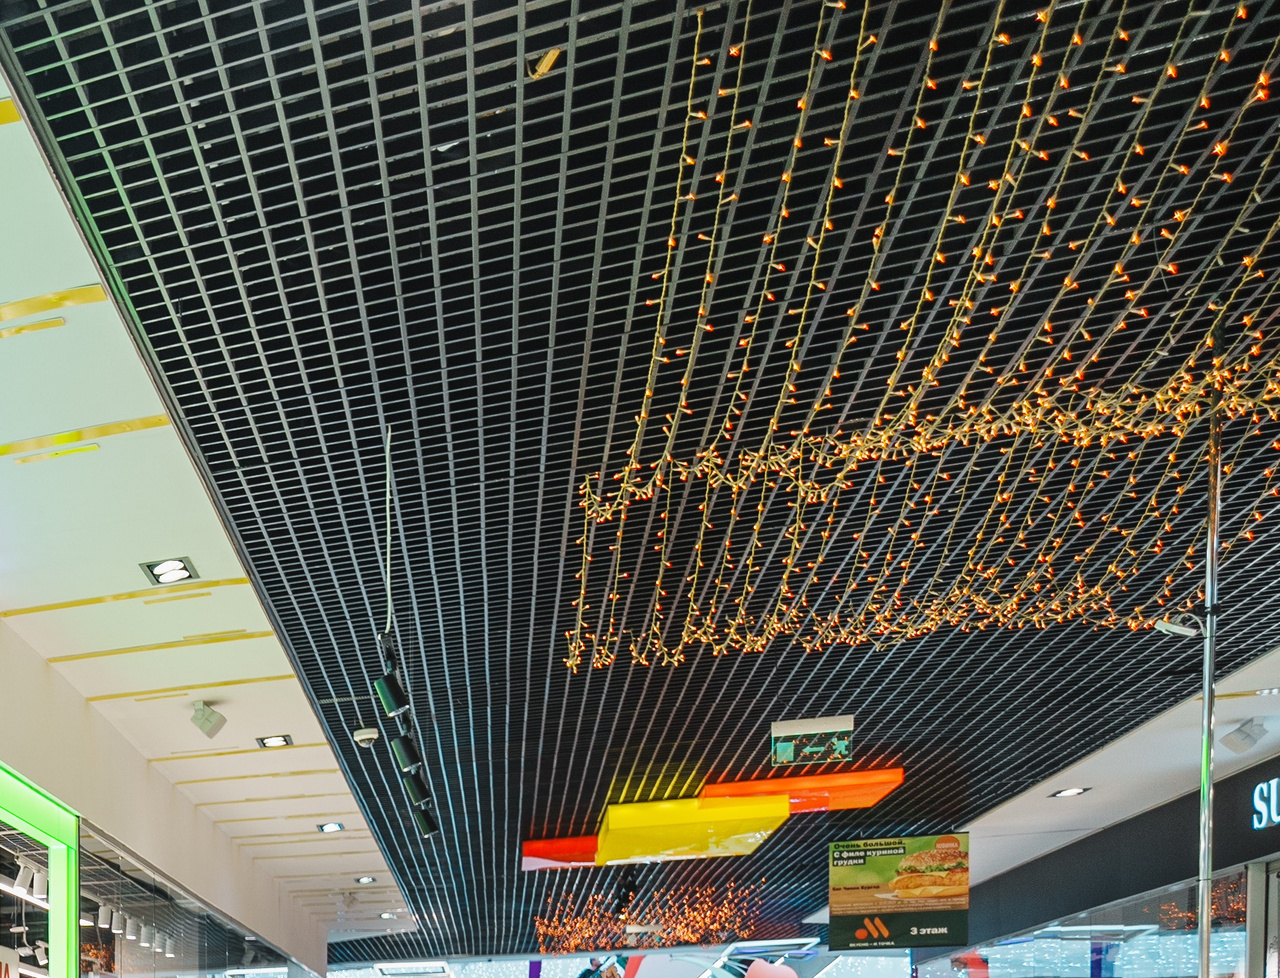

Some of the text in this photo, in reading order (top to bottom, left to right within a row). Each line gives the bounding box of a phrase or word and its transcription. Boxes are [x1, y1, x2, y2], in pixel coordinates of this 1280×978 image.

[866, 848, 905, 857] куриной
[833, 858, 864, 867] грудки
[910, 926, 948, 935] 3 этаж
